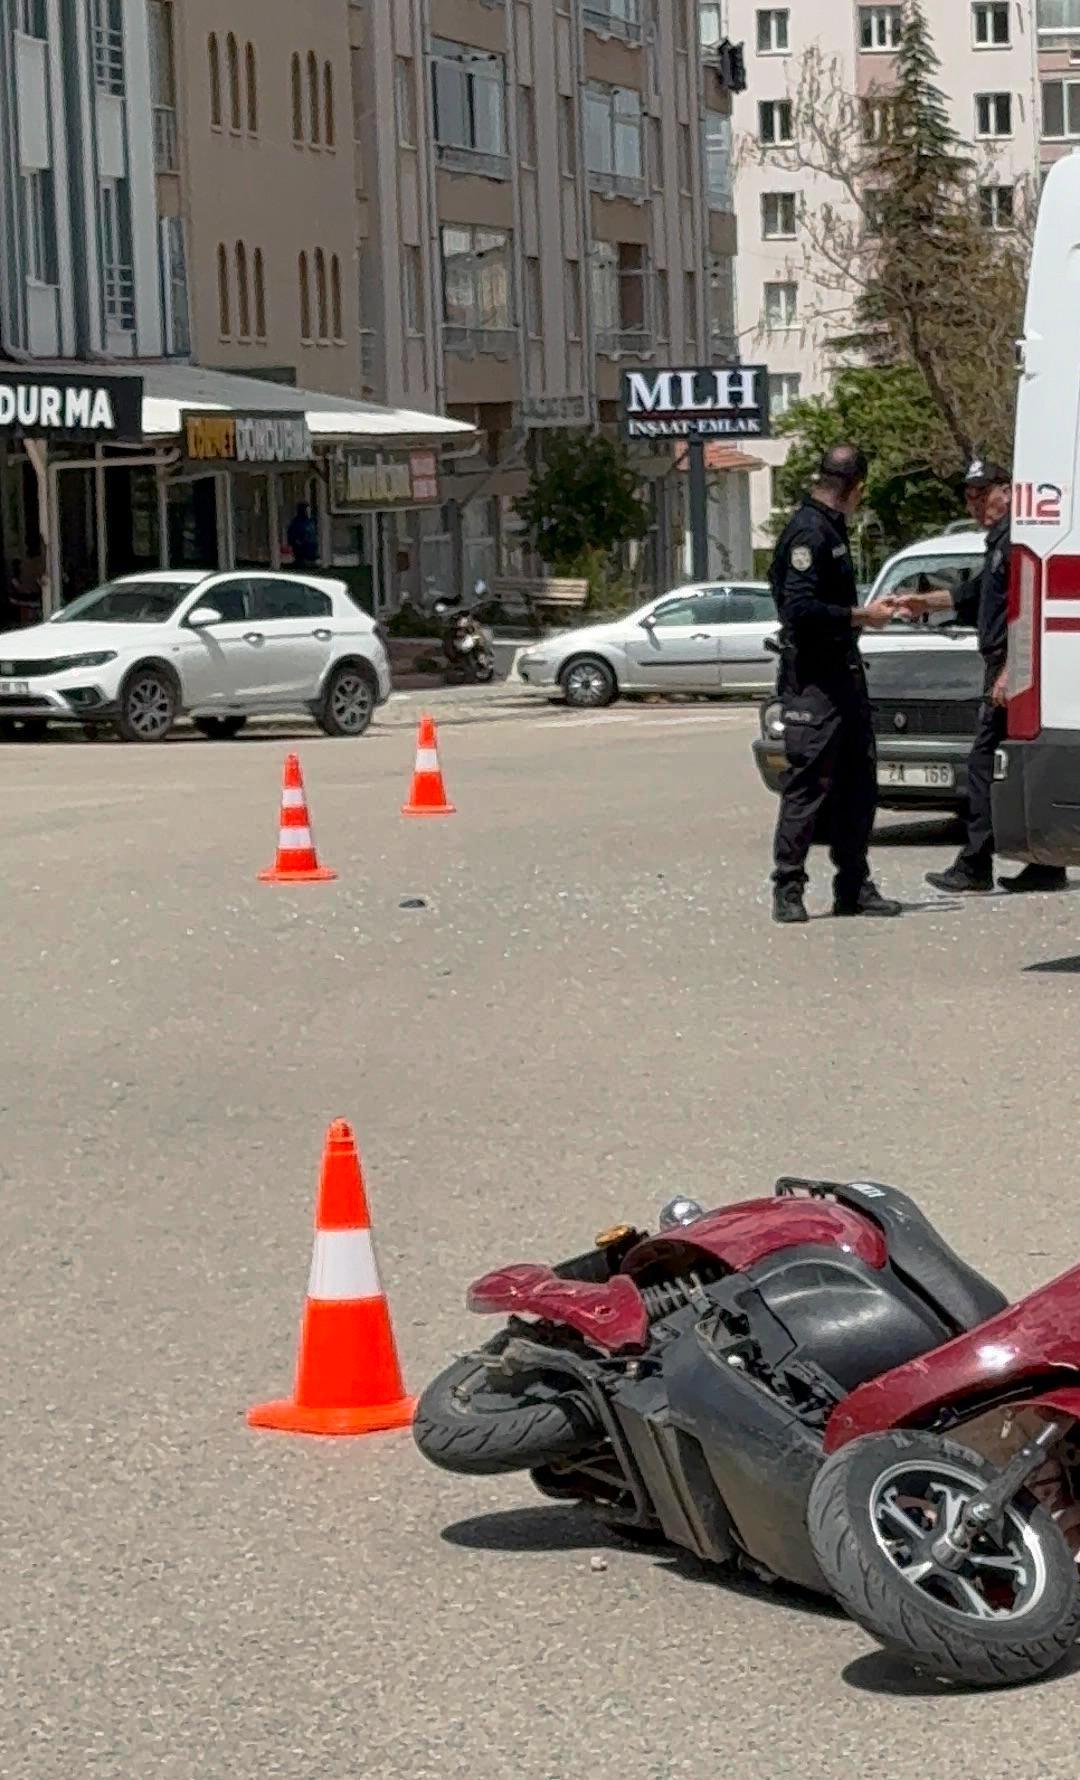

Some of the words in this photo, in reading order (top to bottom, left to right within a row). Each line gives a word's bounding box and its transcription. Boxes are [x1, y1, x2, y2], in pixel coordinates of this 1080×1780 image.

[0, 385, 115, 429] DURMA
[626, 369, 759, 412] MLH
[1015, 482, 1062, 518] 112
